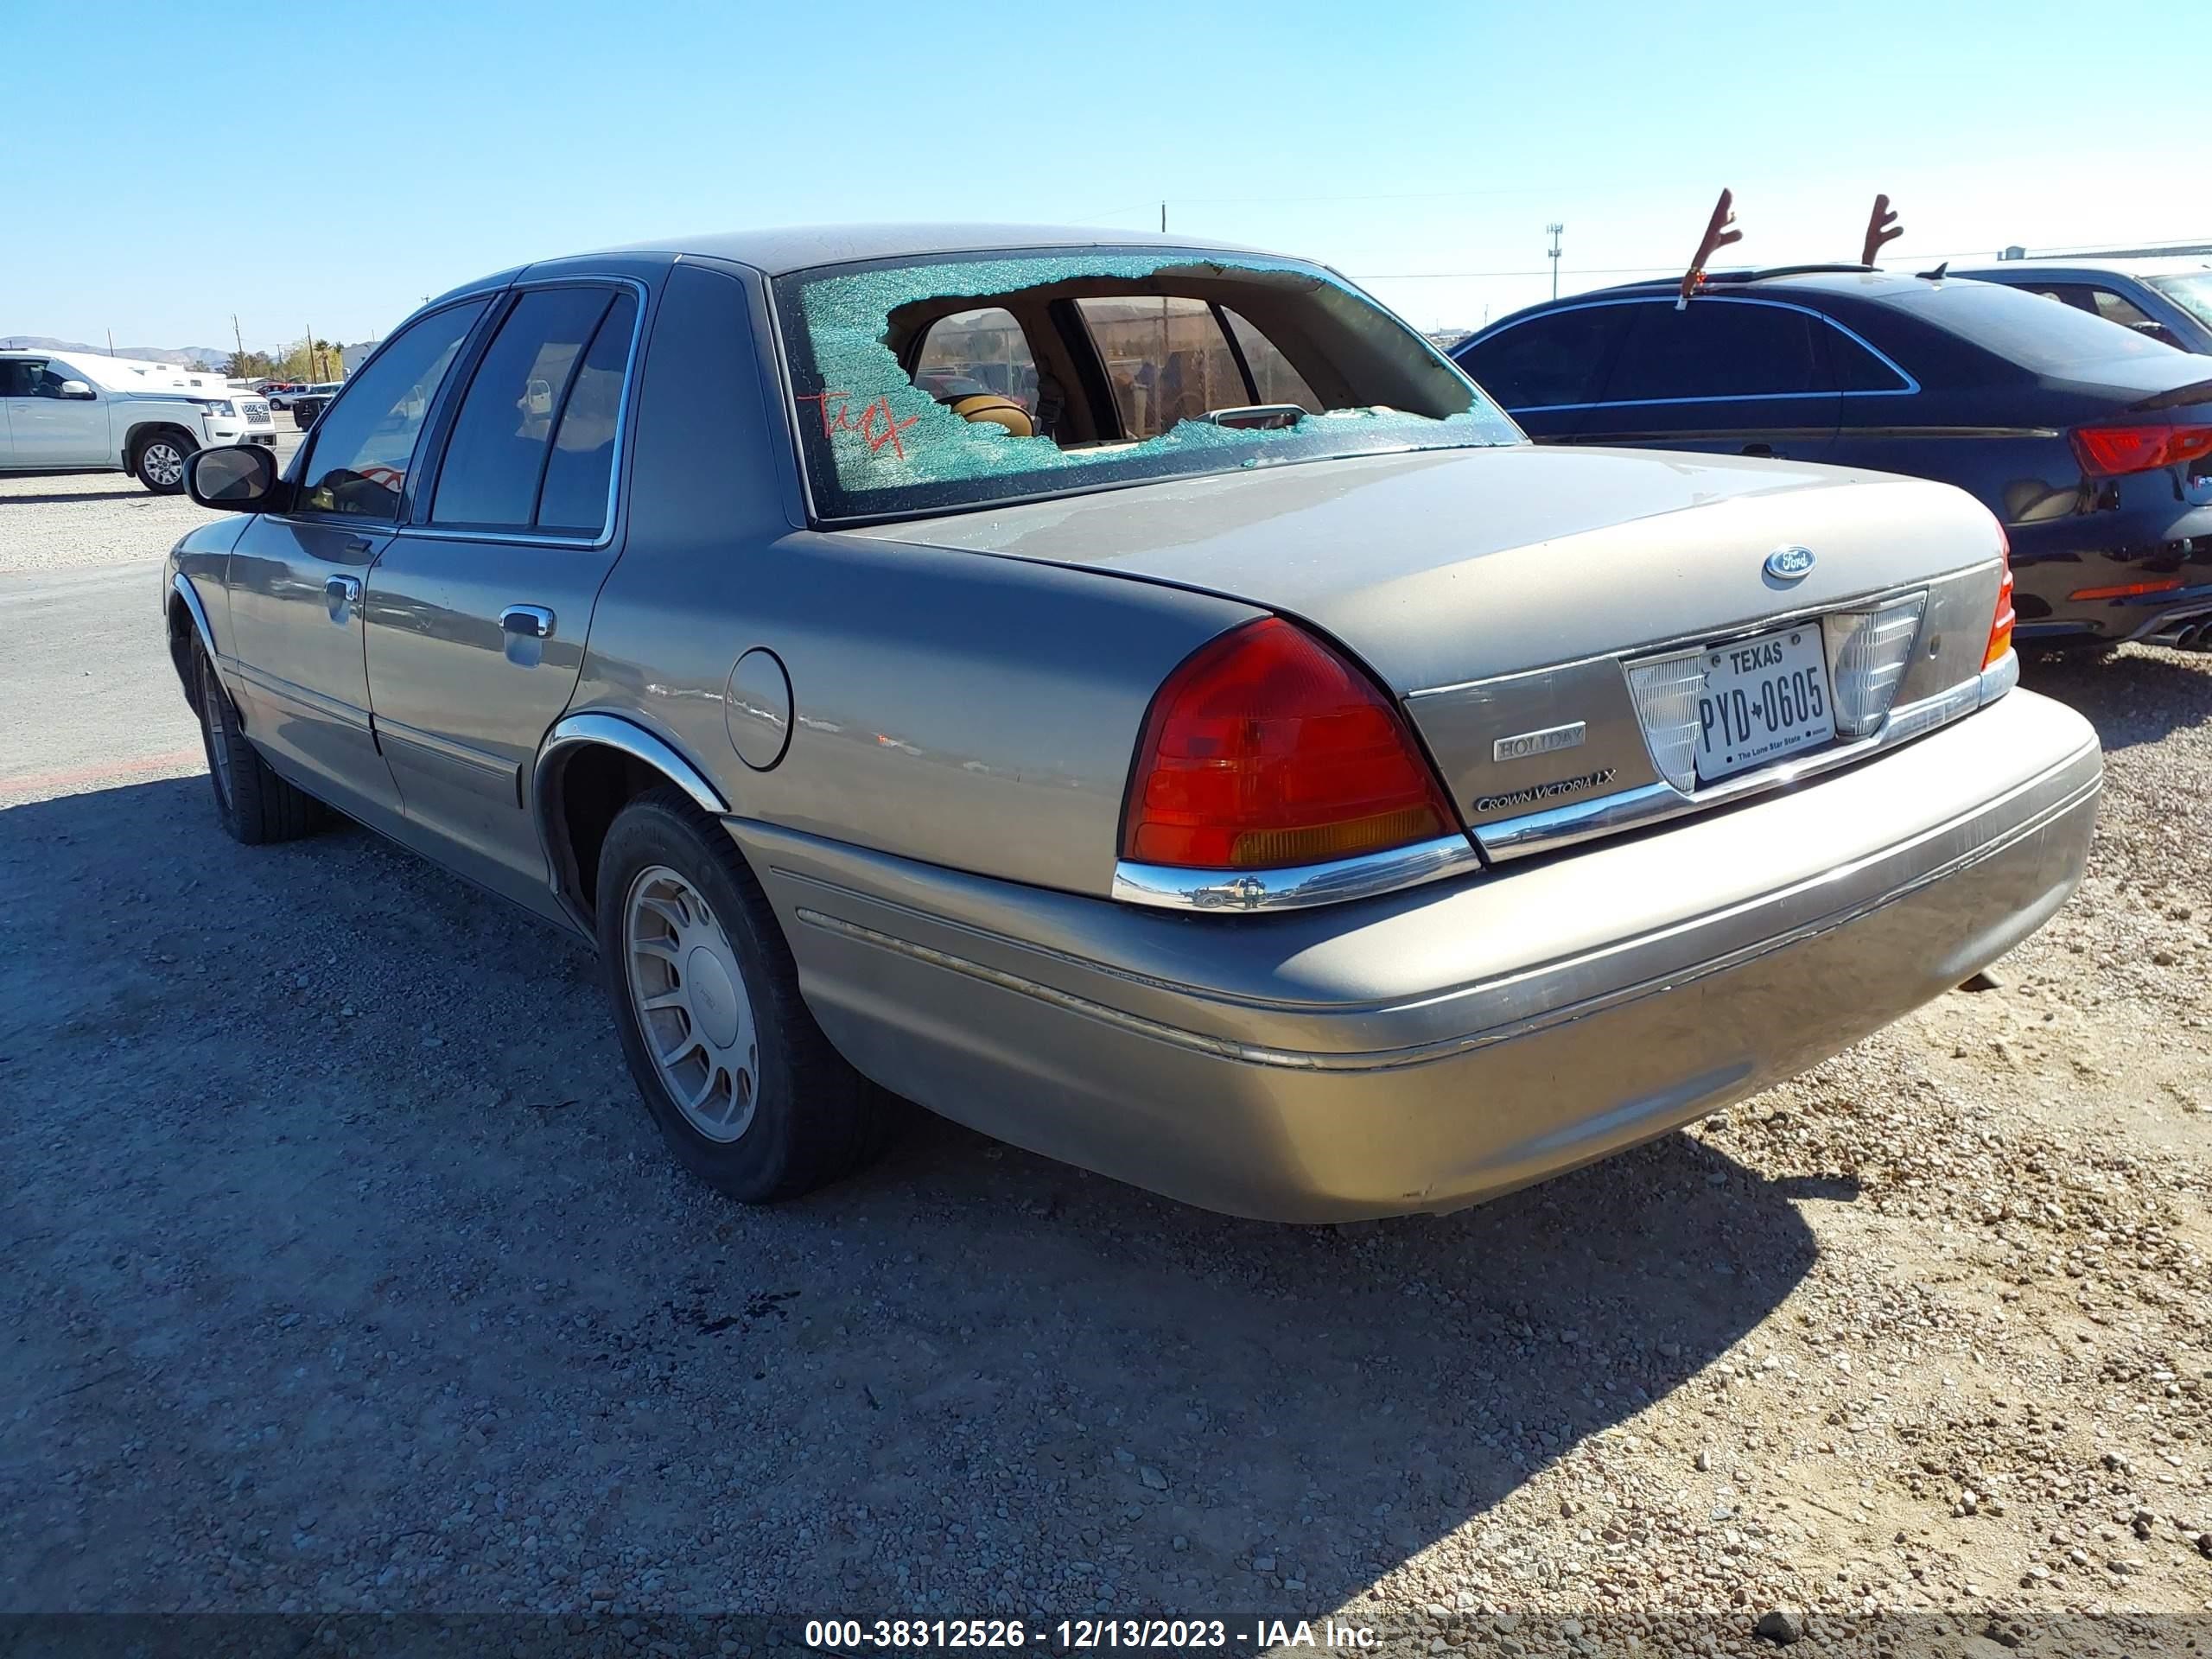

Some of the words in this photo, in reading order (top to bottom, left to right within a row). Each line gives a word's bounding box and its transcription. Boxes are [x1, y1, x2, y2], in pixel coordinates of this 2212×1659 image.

[1783, 550, 1808, 570] Ford
[1730, 641, 1783, 675] TEXAS
[1498, 728, 1583, 758] HOLIDAY
[1738, 750, 1751, 761] The
[1752, 745, 1768, 756] Lone
[1770, 741, 1783, 751] Star
[1784, 735, 1801, 746] State
[1477, 791, 1533, 812] CROWN
[1535, 777, 1592, 798] VICTORIA
[1596, 768, 1618, 785] LX
